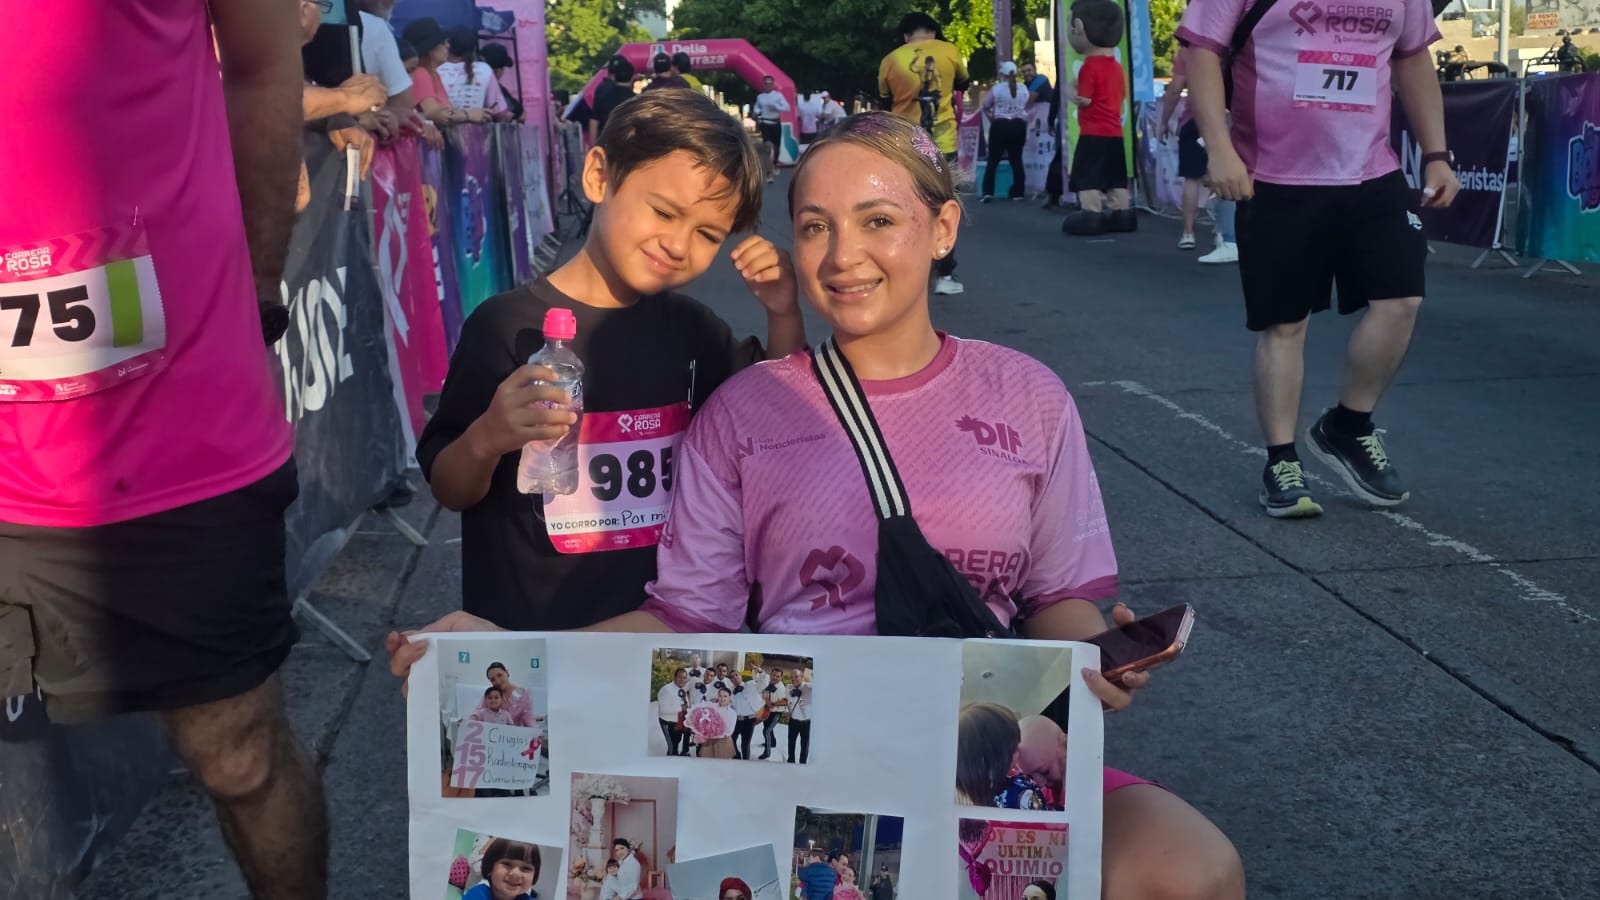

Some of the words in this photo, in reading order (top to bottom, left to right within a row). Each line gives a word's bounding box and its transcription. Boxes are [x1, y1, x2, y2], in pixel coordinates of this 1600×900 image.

[1327, 5, 1393, 19] CARRERA
[1325, 16, 1392, 35] ROSA
[672, 44, 707, 53] Delia
[689, 53, 726, 65] rraza
[1322, 69, 1359, 91] 717
[5, 247, 50, 261] CARRERA
[6, 254, 52, 272] ROSA
[634, 412, 661, 421] CARRERA
[634, 418, 661, 431] ROSA
[759, 433, 826, 451] Noticieristas
[971, 420, 1024, 455] DIF
[550, 521, 563, 530] YO
[565, 519, 597, 529] CORRO
[599, 518, 620, 527] POR:
[621, 510, 645, 526] Por
[944, 548, 1022, 573] RERA
[464, 722, 484, 744] 2
[457, 743, 486, 768] 15
[452, 767, 484, 789] 17
[1016, 830, 1036, 844] ES
[1049, 832, 1067, 845] MI
[997, 845, 1053, 858] ULTIMA
[985, 859, 1063, 876] QUIMIO
